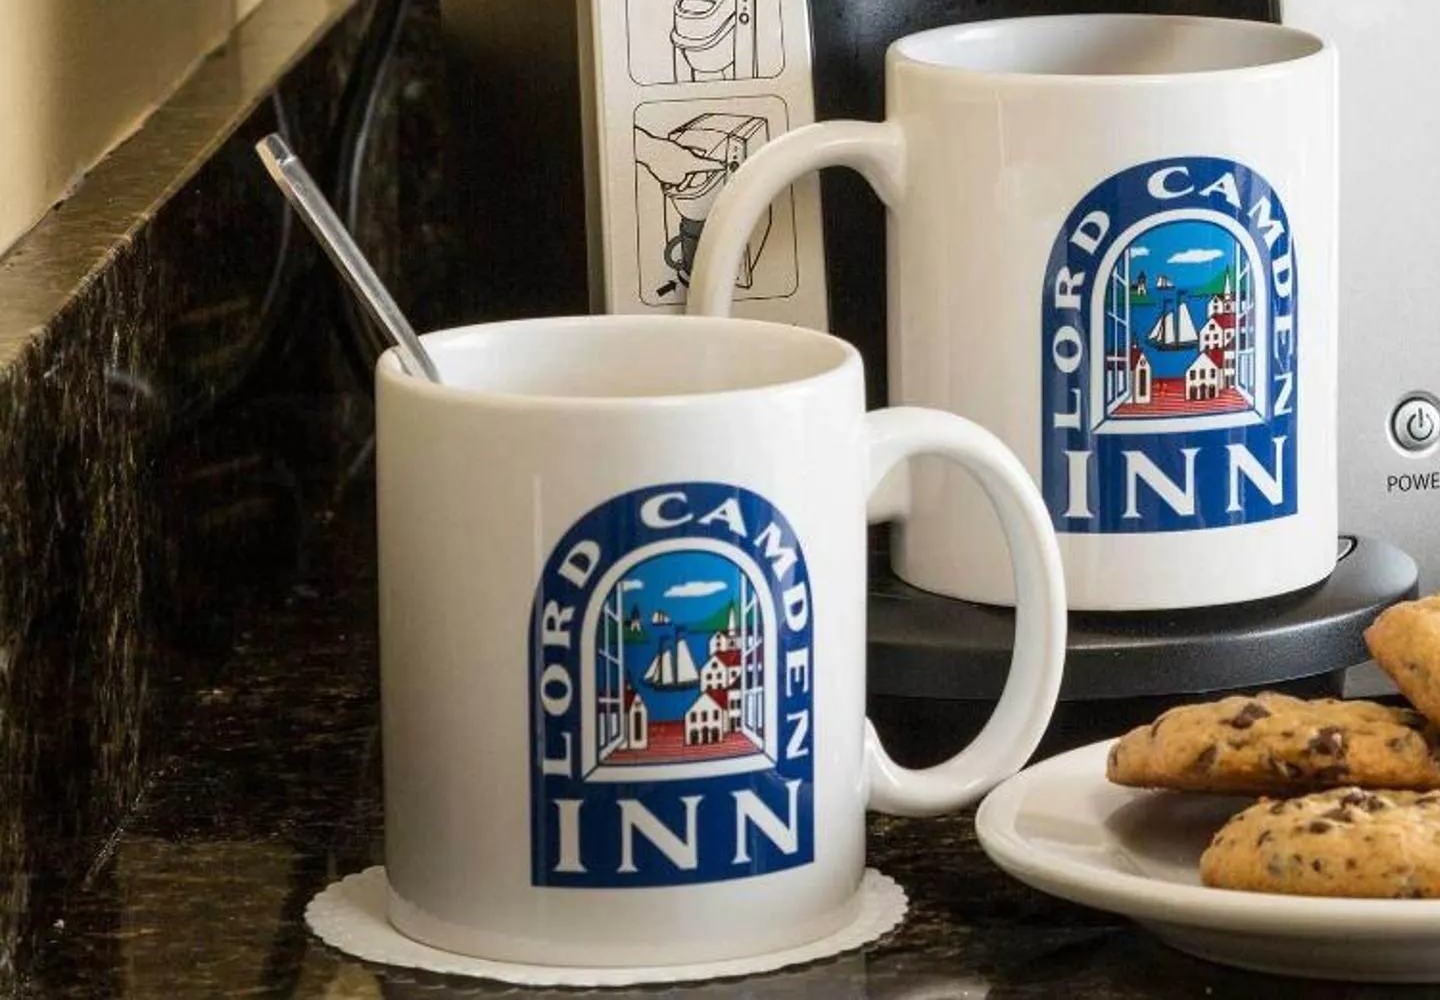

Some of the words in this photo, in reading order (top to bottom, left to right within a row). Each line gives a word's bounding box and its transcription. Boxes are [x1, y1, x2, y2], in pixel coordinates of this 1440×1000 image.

[1052, 209, 1111, 432] LORD
[1146, 165, 1293, 417] CAMDEN
[1062, 436, 1287, 518] INN
[541, 538, 603, 780] LORD
[640, 492, 810, 761] CAMDEN
[552, 779, 803, 873] INN
